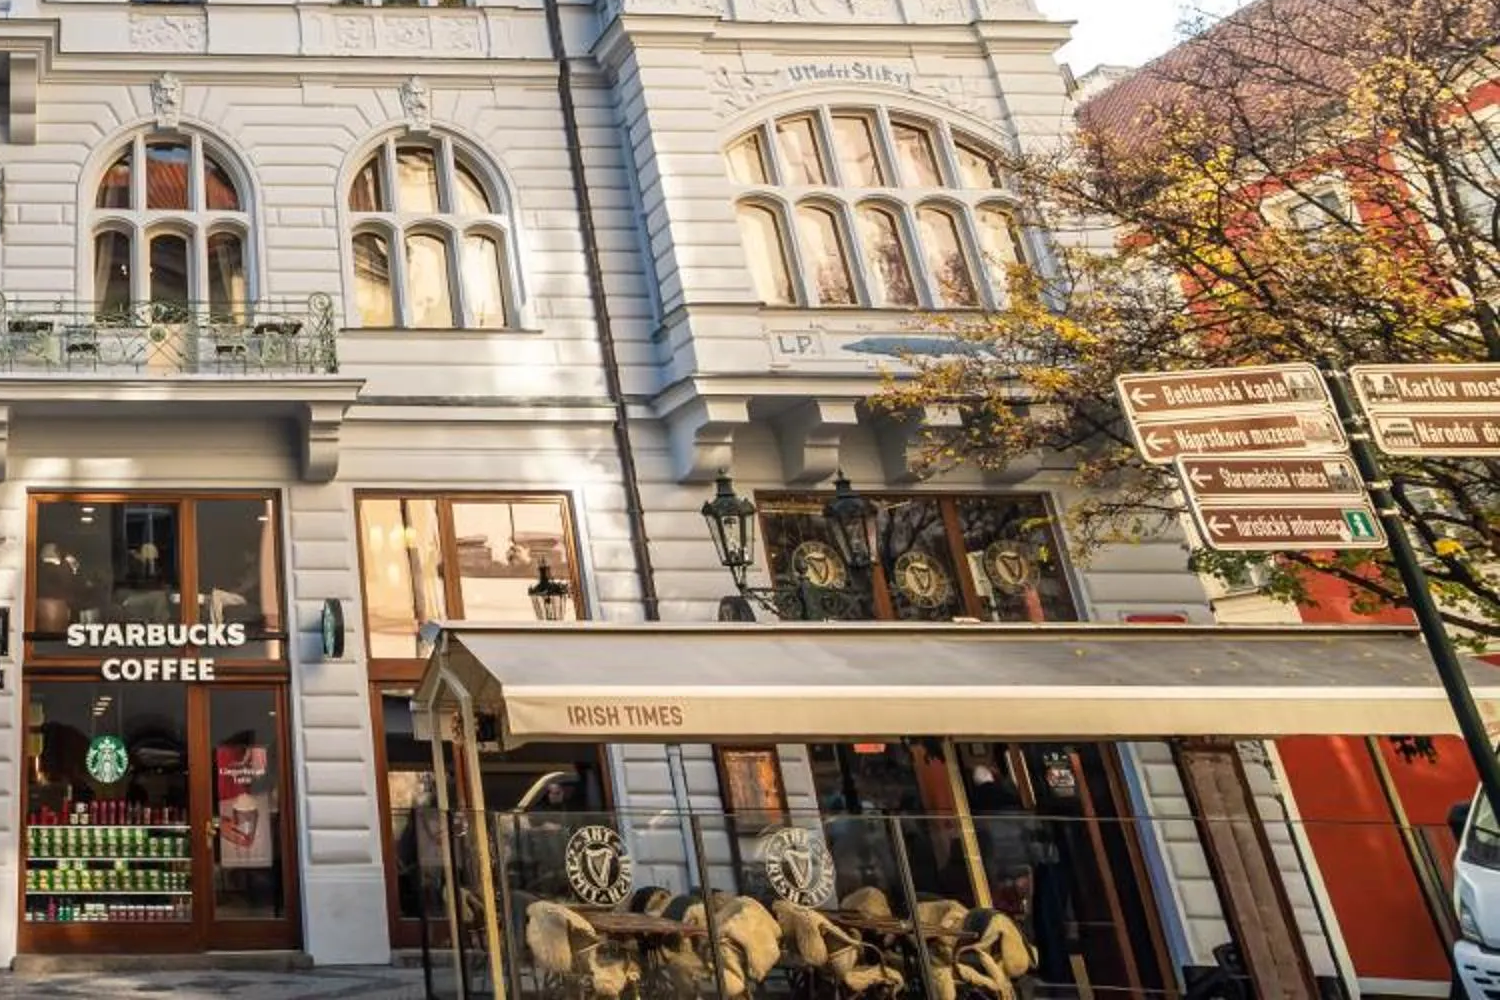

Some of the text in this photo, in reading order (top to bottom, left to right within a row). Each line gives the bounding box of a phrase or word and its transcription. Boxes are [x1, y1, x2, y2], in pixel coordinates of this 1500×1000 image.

[1162, 377, 1289, 405] Betlémská kaple
[1398, 377, 1457, 397] Karlův
[1250, 424, 1305, 444] muzeum
[1416, 420, 1479, 443] Národní
[67, 623, 246, 647] STARBUCKS
[101, 658, 216, 682] COFFEE
[566, 705, 684, 727] IRISH TIMES
